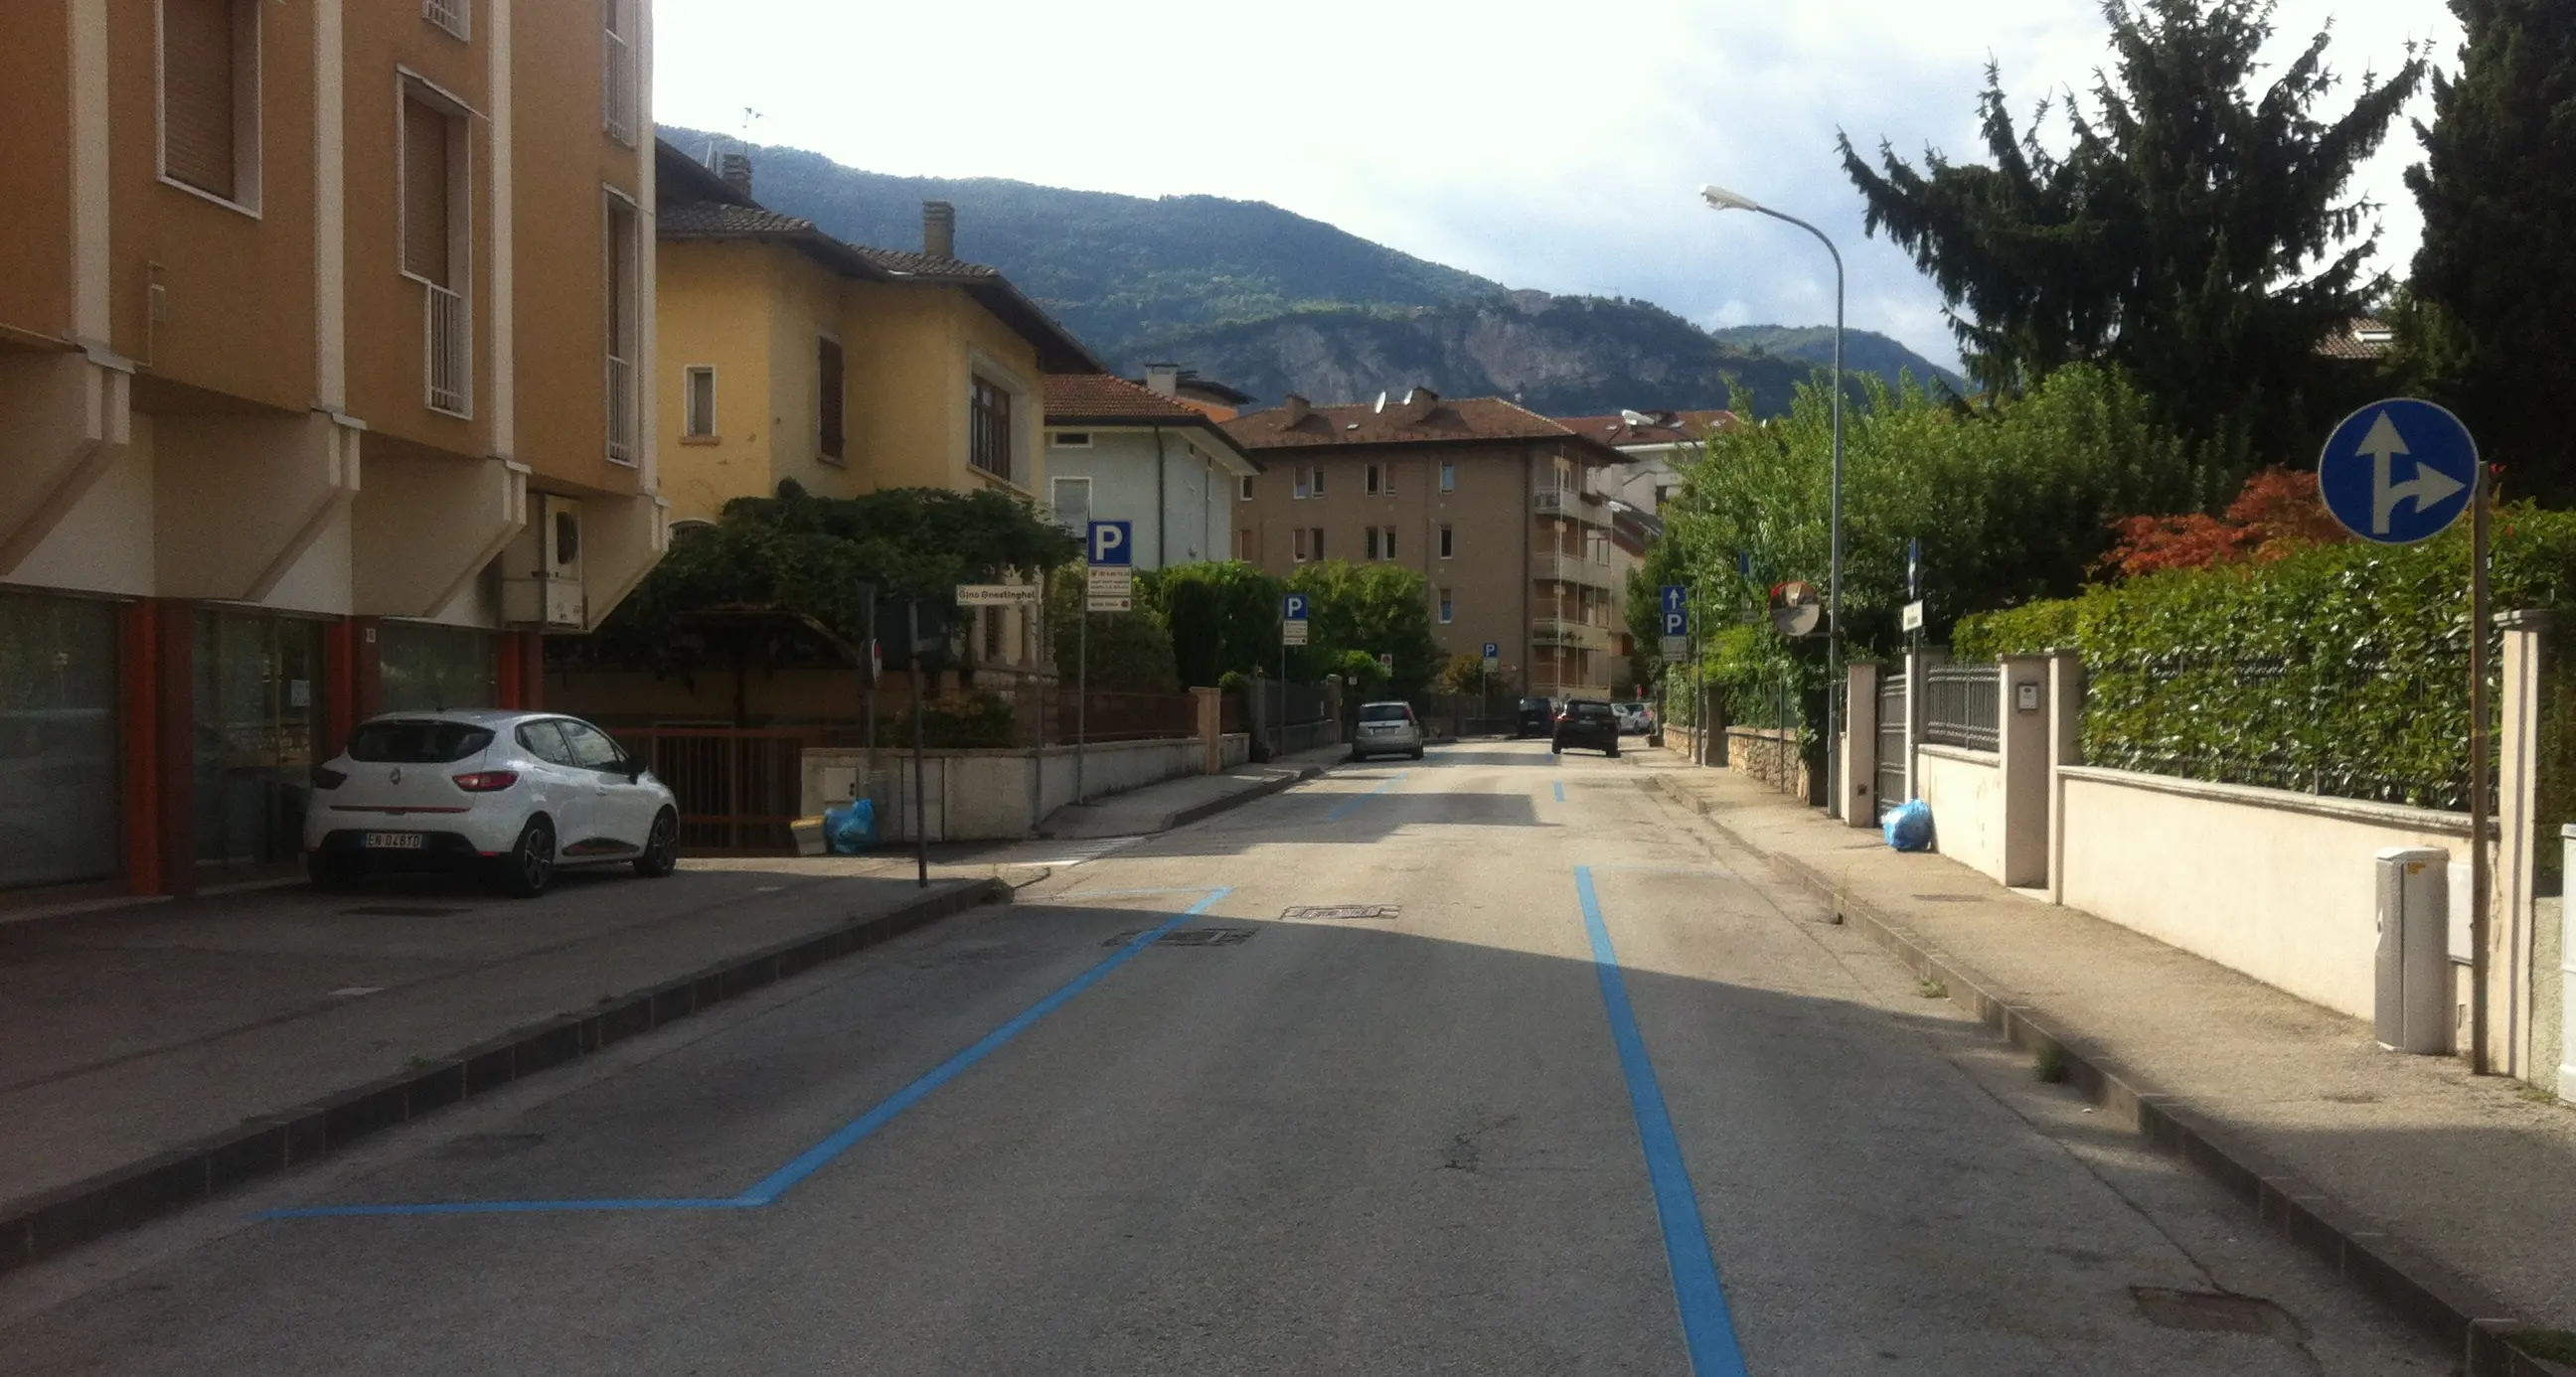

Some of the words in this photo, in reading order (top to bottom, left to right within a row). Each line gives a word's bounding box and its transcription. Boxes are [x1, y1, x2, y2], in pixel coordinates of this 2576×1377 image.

[1096, 525, 1123, 560] P
[1288, 597, 1303, 617] P
[1667, 614, 1683, 633] P
[1486, 644, 1496, 657] P
